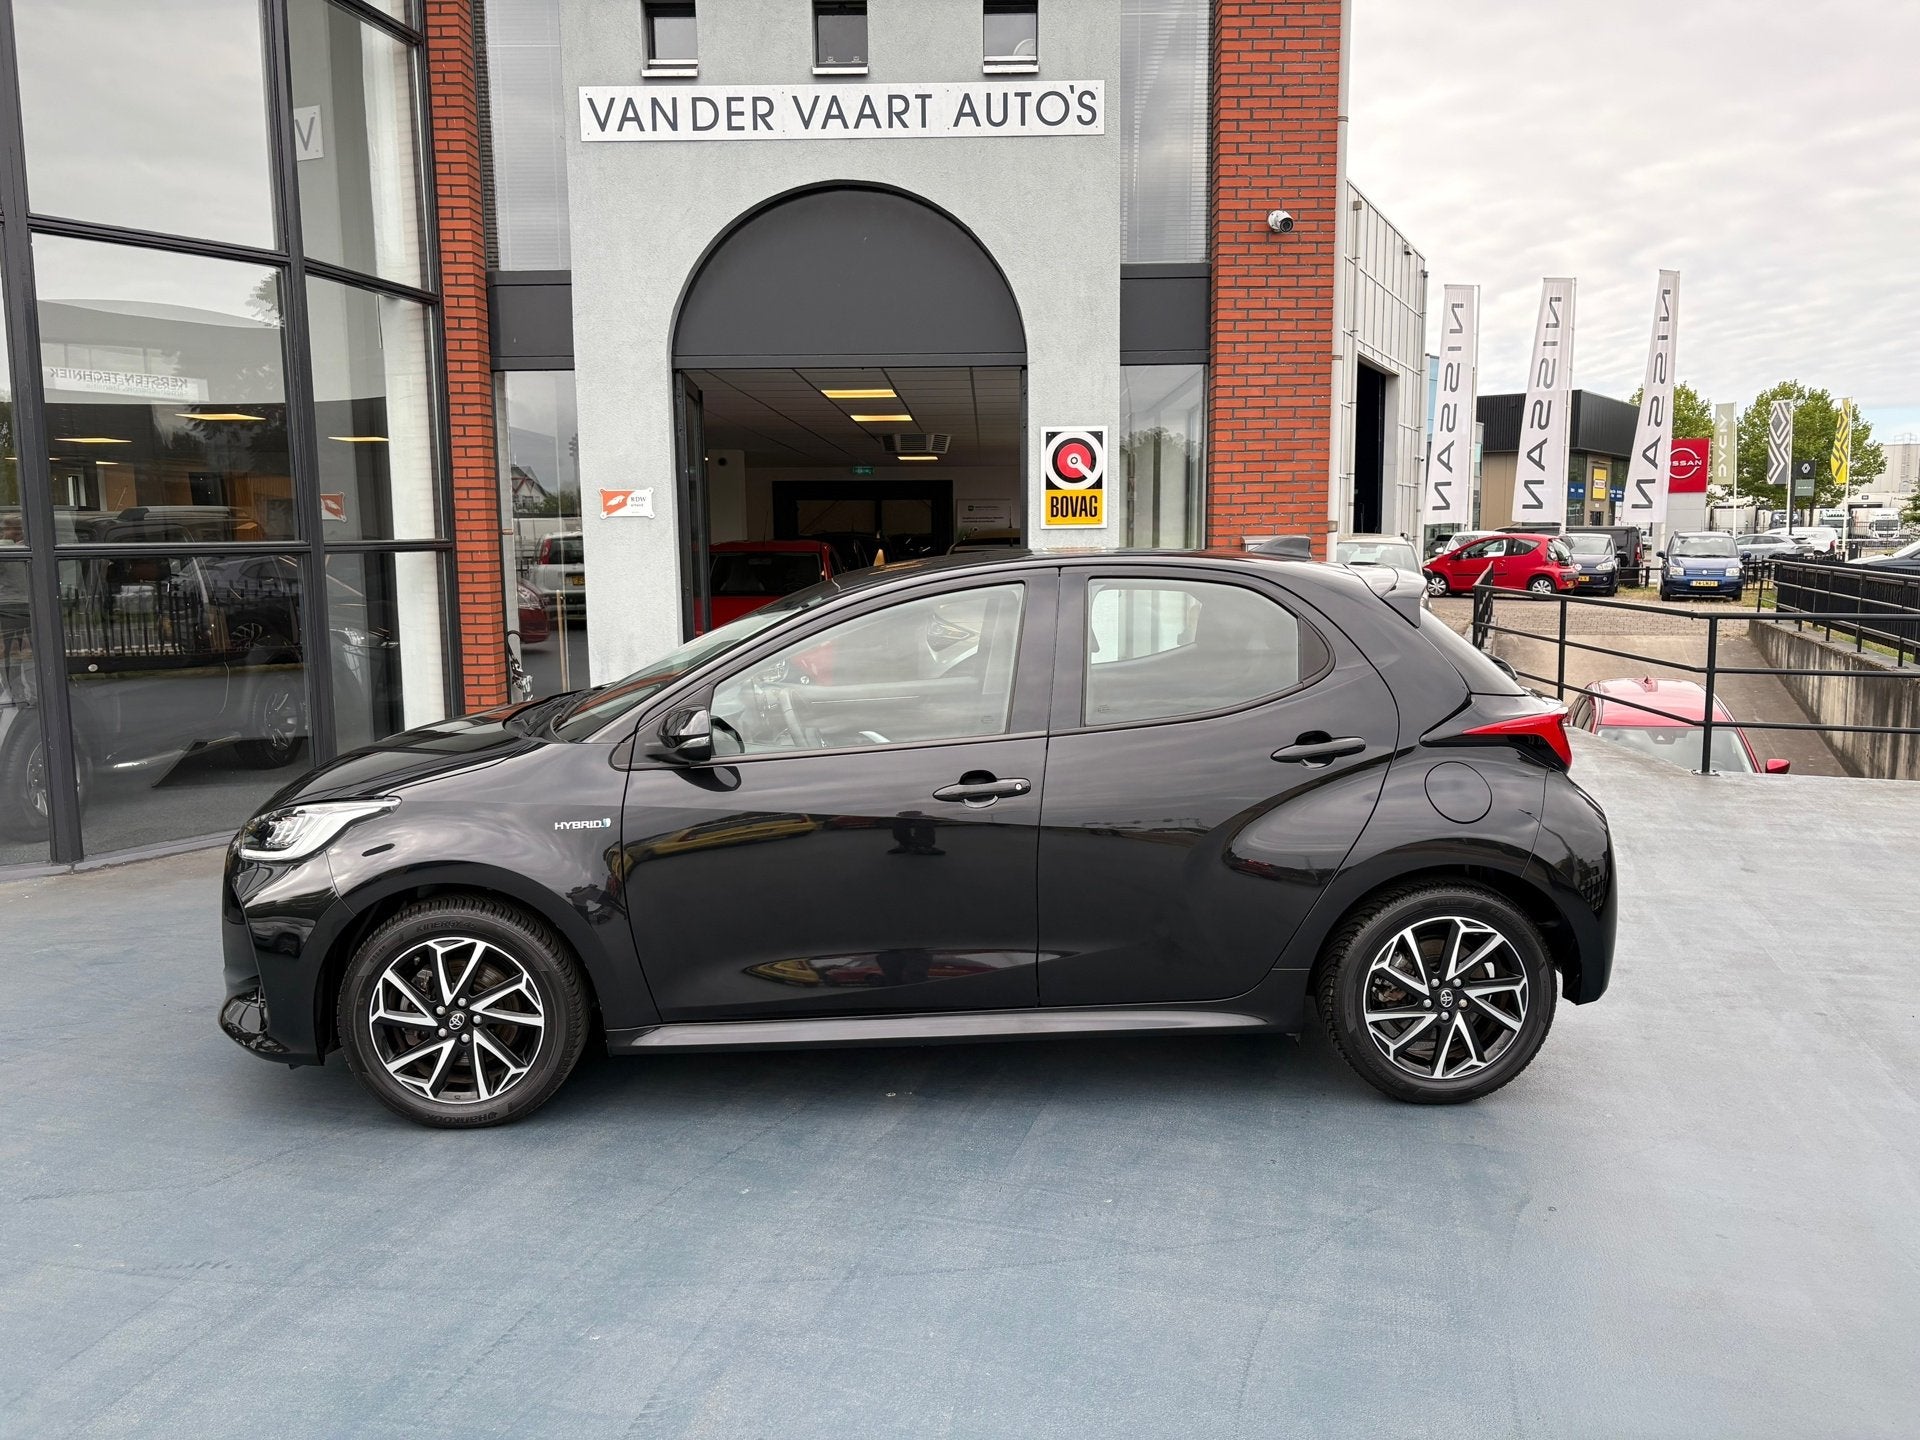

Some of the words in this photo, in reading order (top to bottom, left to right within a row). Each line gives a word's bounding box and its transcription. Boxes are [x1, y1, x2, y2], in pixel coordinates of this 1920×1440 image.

[587, 96, 679, 132] VAN
[691, 96, 775, 132] DER
[792, 93, 933, 130] VAART
[952, 85, 1098, 128] AUTO'S
[1669, 459, 1702, 467] SSAN
[1050, 495, 1098, 518] BOVAG
[554, 819, 602, 831] HYBRID
